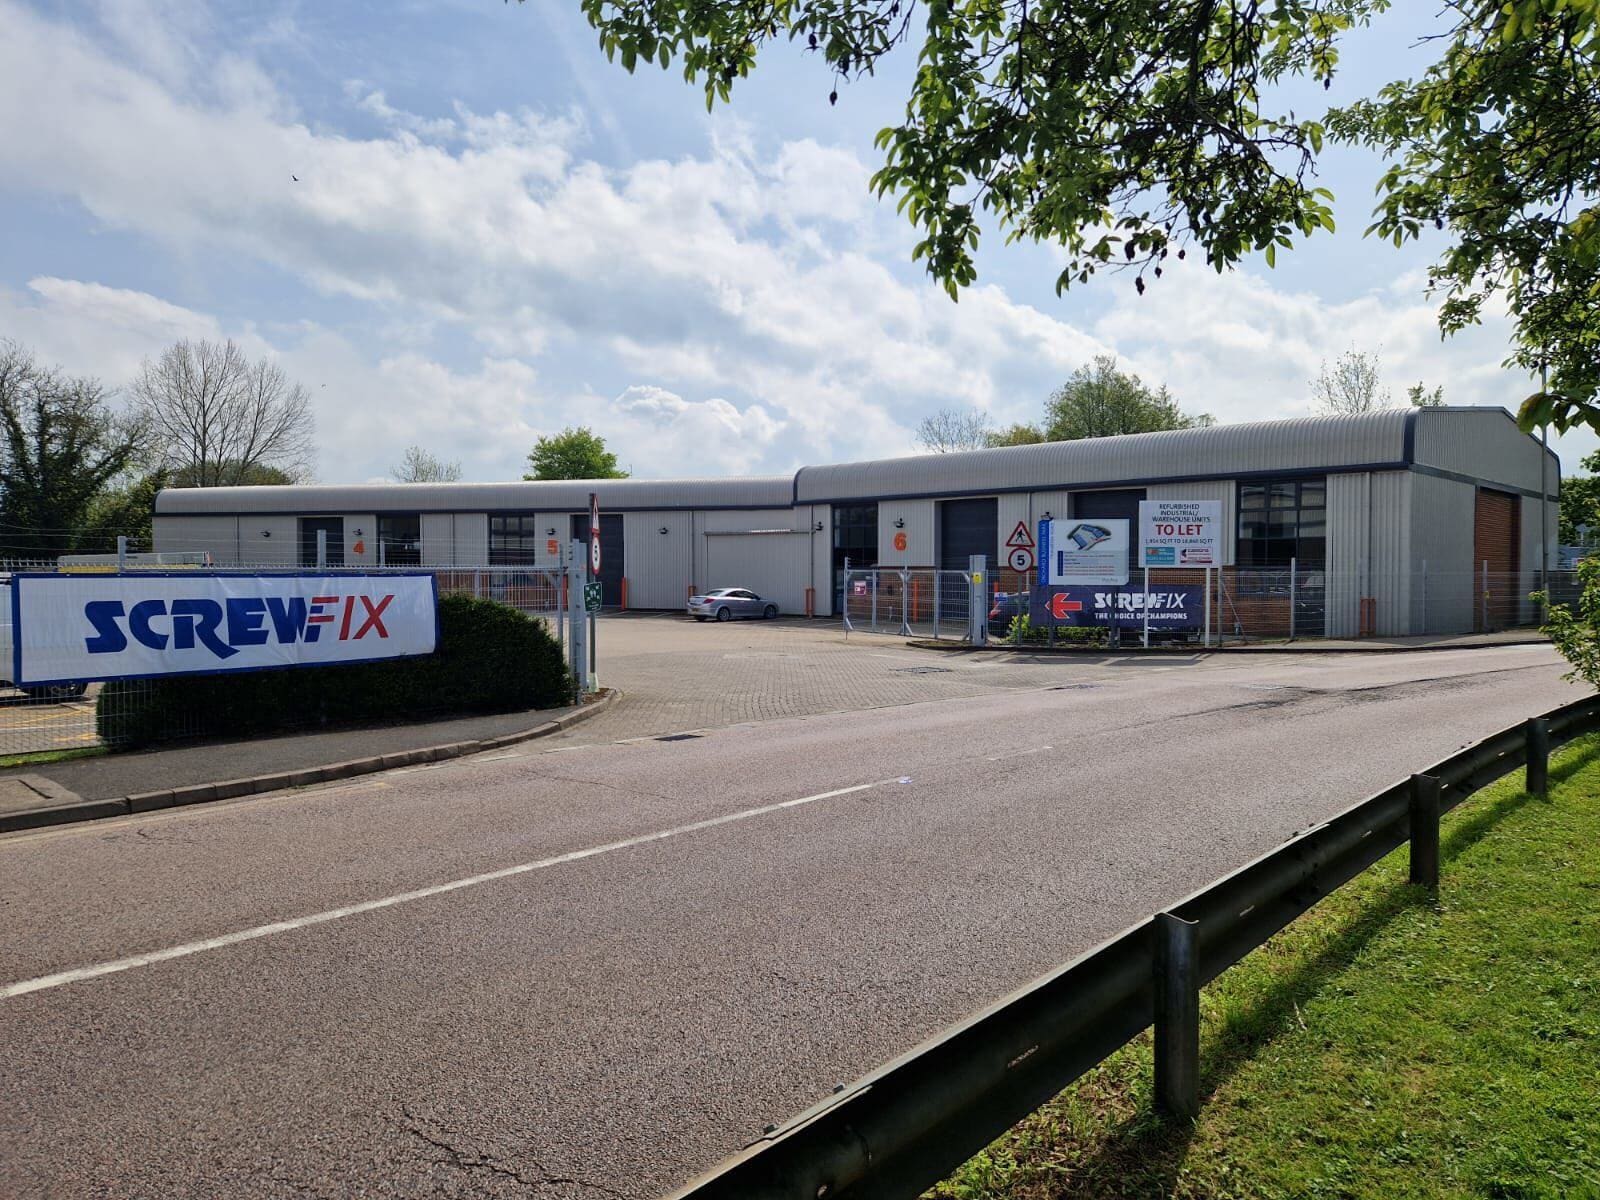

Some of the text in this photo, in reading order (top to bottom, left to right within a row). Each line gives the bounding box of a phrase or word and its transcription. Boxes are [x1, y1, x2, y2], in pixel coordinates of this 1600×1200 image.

[1155, 524, 1203, 536] TO LET
[353, 540, 365, 555] 4
[547, 539, 559, 556] 5
[894, 532, 906, 551] 6
[1017, 554, 1026, 566] 5
[1094, 592, 1188, 612] SCREWFIX
[1094, 612, 1108, 620] THE
[1147, 612, 1188, 620] CHAMPIONS
[84, 594, 395, 660] SCREWFIX
